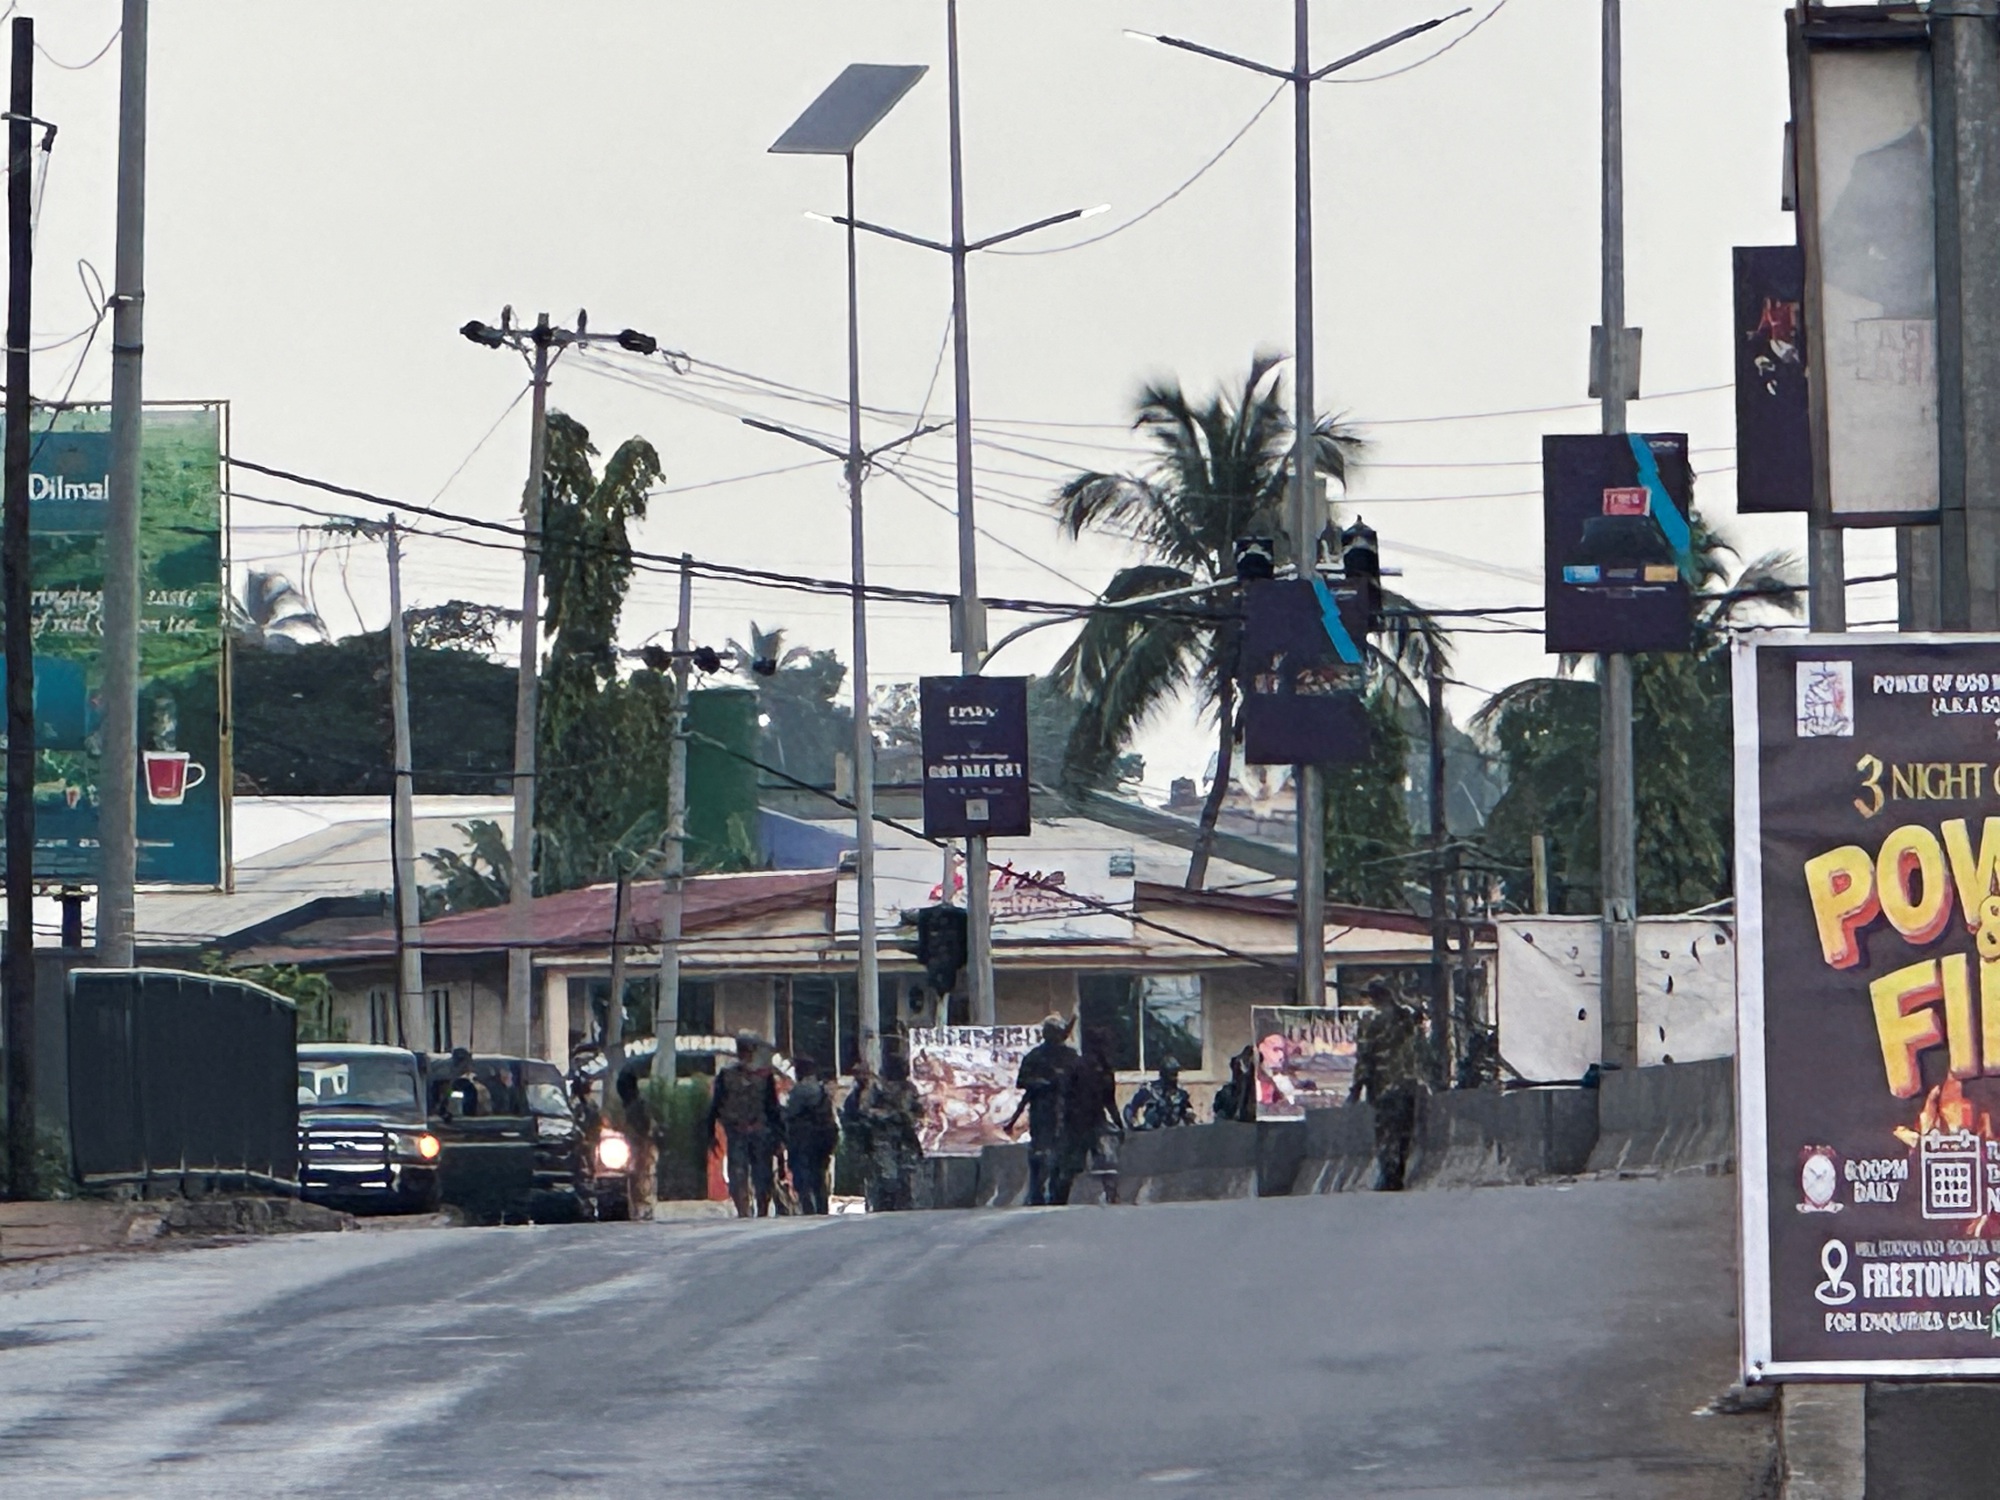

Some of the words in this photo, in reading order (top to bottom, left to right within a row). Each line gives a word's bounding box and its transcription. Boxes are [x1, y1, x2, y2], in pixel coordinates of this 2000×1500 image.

[1854, 754, 1885, 819] 3
[1891, 763, 1988, 800] NIGHT
[1854, 1181, 1900, 1203] DAILY
[1863, 1261, 1980, 1299] FREETOWN
[1825, 1312, 1857, 1332] FOR
[1860, 1311, 1944, 1334] ENQUIRIES
